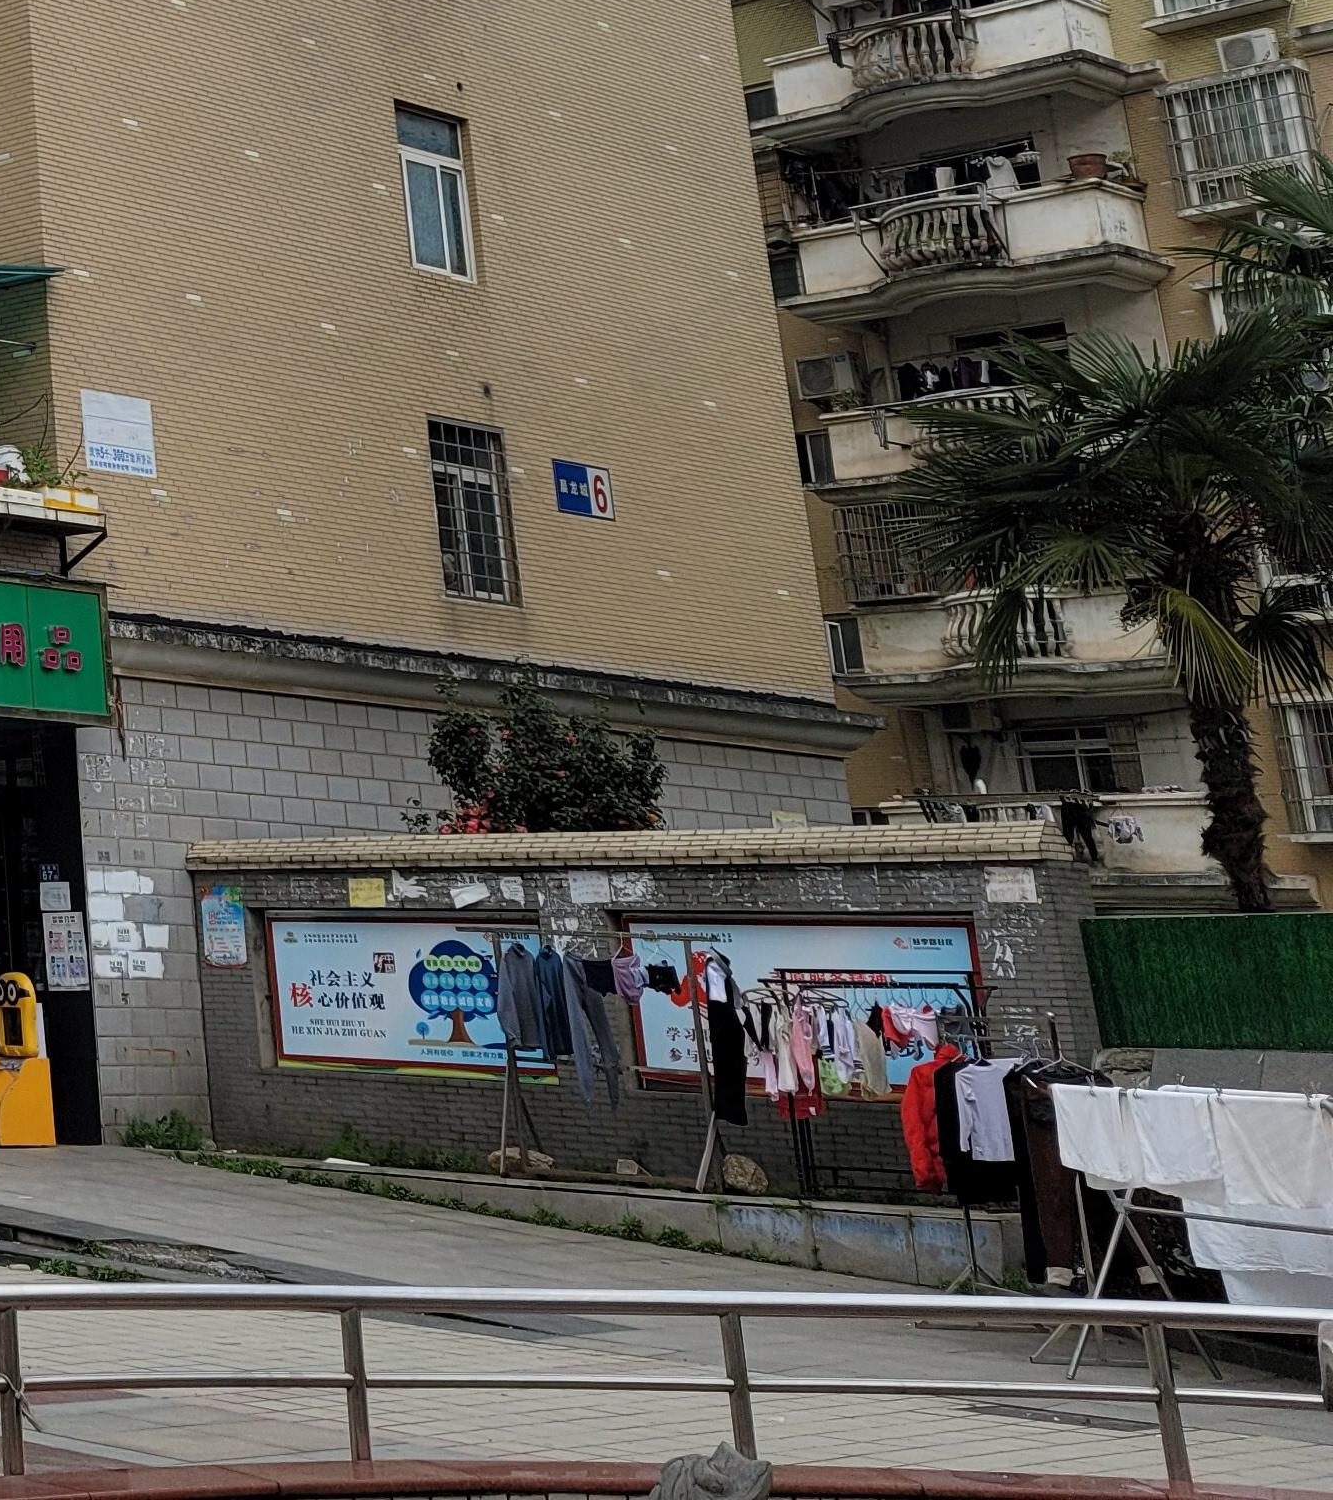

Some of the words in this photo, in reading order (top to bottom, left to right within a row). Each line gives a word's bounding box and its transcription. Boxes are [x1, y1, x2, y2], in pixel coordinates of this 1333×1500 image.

[593, 474, 608, 514] 6
[309, 969, 375, 988] 社会主义
[290, 982, 386, 1010] 核心价值观
